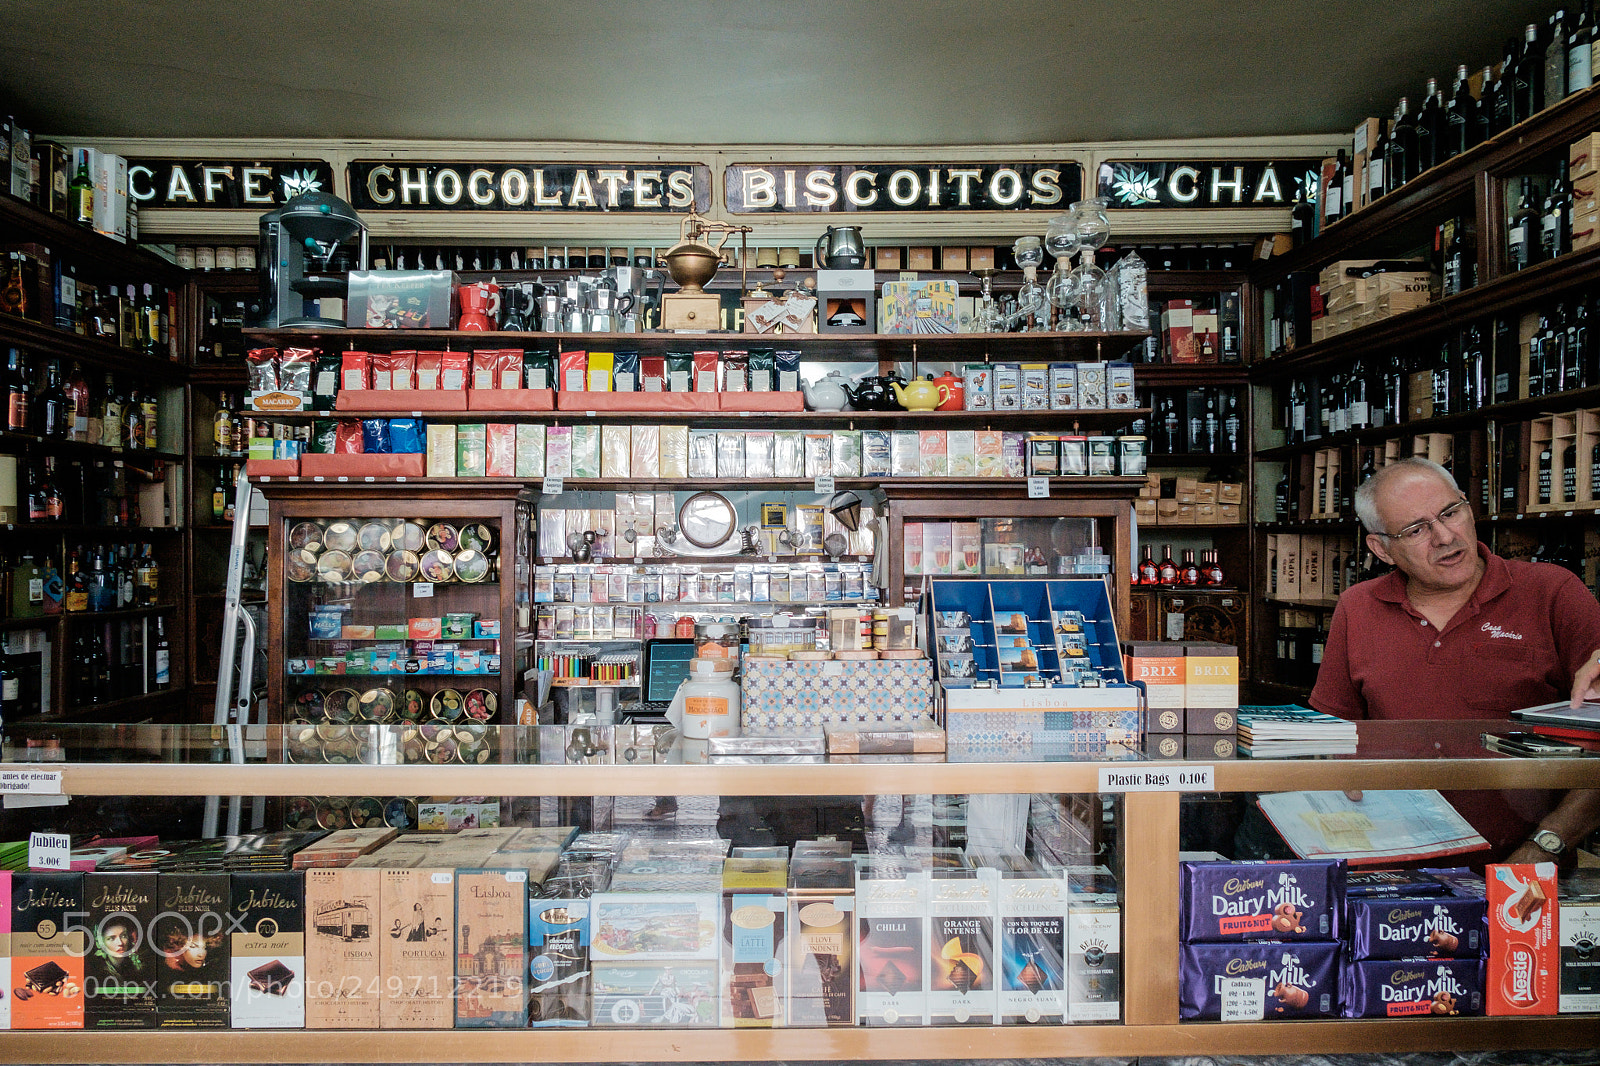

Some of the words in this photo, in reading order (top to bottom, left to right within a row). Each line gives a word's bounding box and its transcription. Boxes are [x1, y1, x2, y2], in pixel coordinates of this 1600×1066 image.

[128, 162, 275, 203] CAFÉ
[367, 164, 695, 207] CHOCOLATES
[742, 168, 1063, 207] BISCOITOS
[1168, 162, 1283, 203] CHÁ
[1288, 552, 1296, 584] KOPKE
[1310, 551, 1318, 583] KOPKE
[1481, 622, 1501, 632] Casa
[1140, 666, 1177, 677] BRIX
[1193, 665, 1230, 676] BRIX
[1022, 698, 1069, 708] Lisboa
[1108, 774, 1142, 785] Plastic
[1145, 773, 1170, 786] Bags
[1179, 772, 1208, 784] 0.10€
[31, 835, 68, 849] Jubileu
[38, 856, 61, 867] 3.00€
[470, 885, 511, 899] Lisboa
[1223, 877, 1264, 896] Cadbury
[17, 887, 77, 911] Jubileu
[92, 884, 149, 908] Jubileu
[164, 885, 223, 908] Jubileu
[237, 888, 298, 912] Jubileu
[1212, 895, 1265, 917] Dairy
[1267, 886, 1315, 909] Milk
[943, 920, 981, 928] ORANGE
[1388, 908, 1422, 924] Cadbury
[876, 923, 906, 932] CHILLI
[943, 927, 981, 935] INTENSE
[1379, 923, 1422, 942] Dairy
[1424, 916, 1463, 935] Milk
[270, 941, 289, 949] noir
[1079, 938, 1109, 951] BELUGA
[1569, 931, 1599, 943] BELUGA
[1225, 958, 1267, 975] Cadbury
[1269, 966, 1317, 988] Milk
[1391, 969, 1425, 985] Cadbury
[1513, 951, 1528, 1001] Nestlé
[1381, 984, 1425, 1003] Dairy
[1427, 976, 1467, 996] Milk
